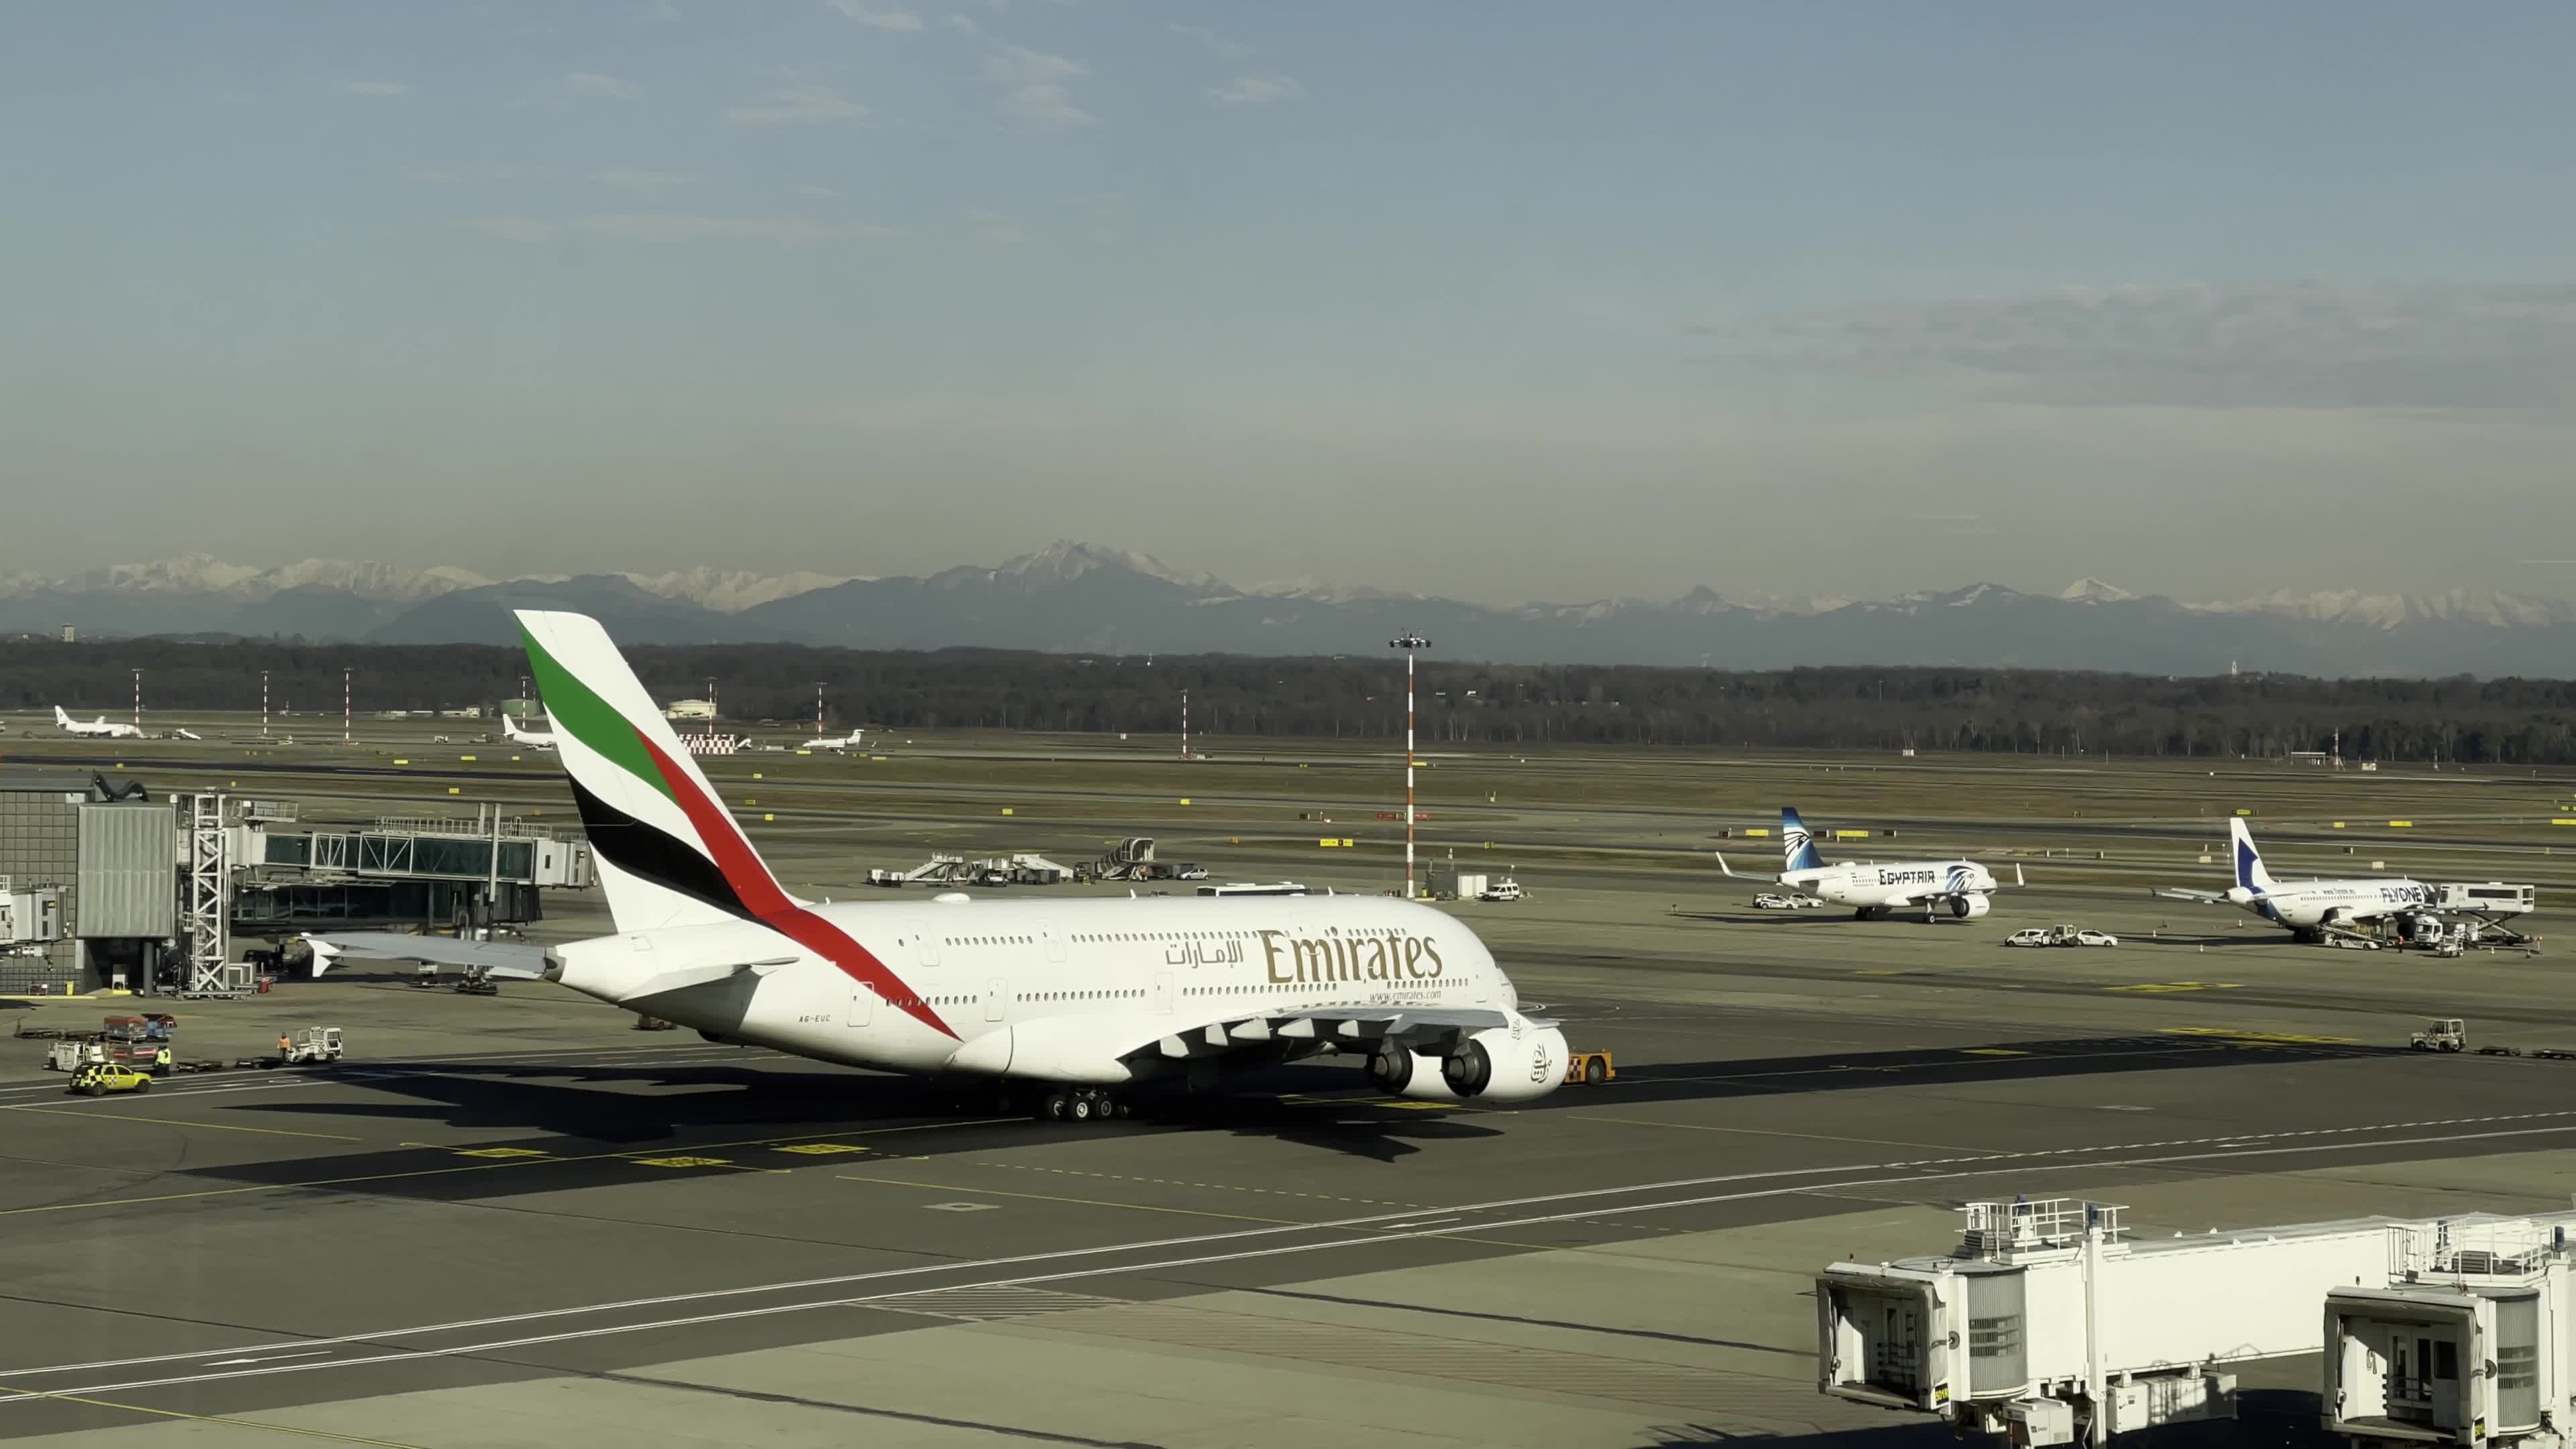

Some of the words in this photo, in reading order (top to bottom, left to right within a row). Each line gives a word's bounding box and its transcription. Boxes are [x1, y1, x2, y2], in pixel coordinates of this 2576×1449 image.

[2380, 888, 2422, 903] FLYONE
[1258, 930, 1442, 984] Emirates
[1369, 991, 1442, 1001] www.emirates.com
[798, 1014, 830, 1022] A6-EUC
